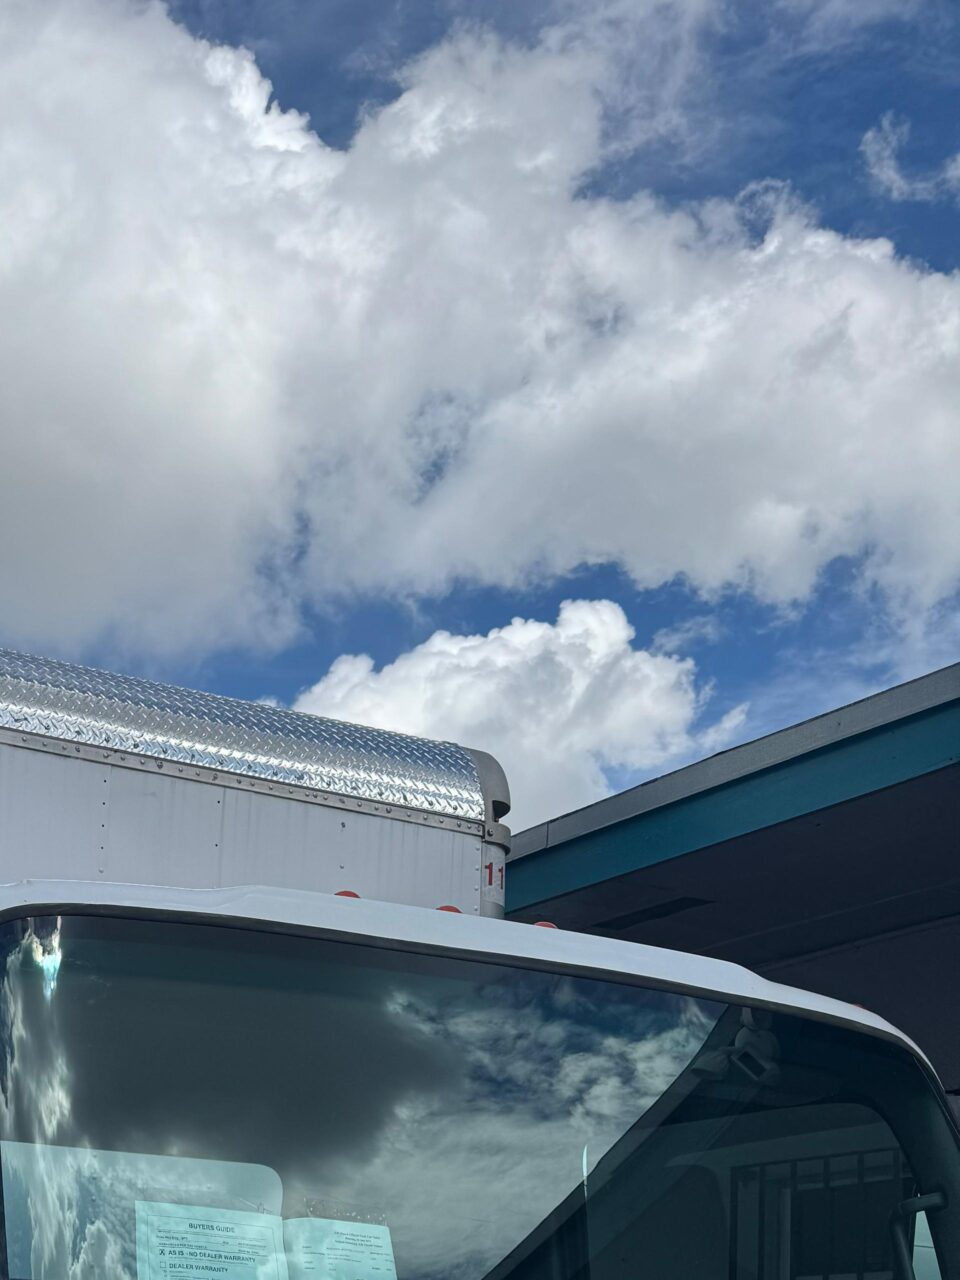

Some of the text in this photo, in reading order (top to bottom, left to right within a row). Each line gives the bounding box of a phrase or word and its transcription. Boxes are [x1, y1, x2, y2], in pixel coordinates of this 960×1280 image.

[188, 1222, 236, 1234] BUYERS GUIDE
[178, 1249, 185, 1257] IS
[199, 1252, 223, 1261] DEALER
[224, 1255, 256, 1264] WARRANTY
[169, 1262, 229, 1273] DEALER WARRANTY
